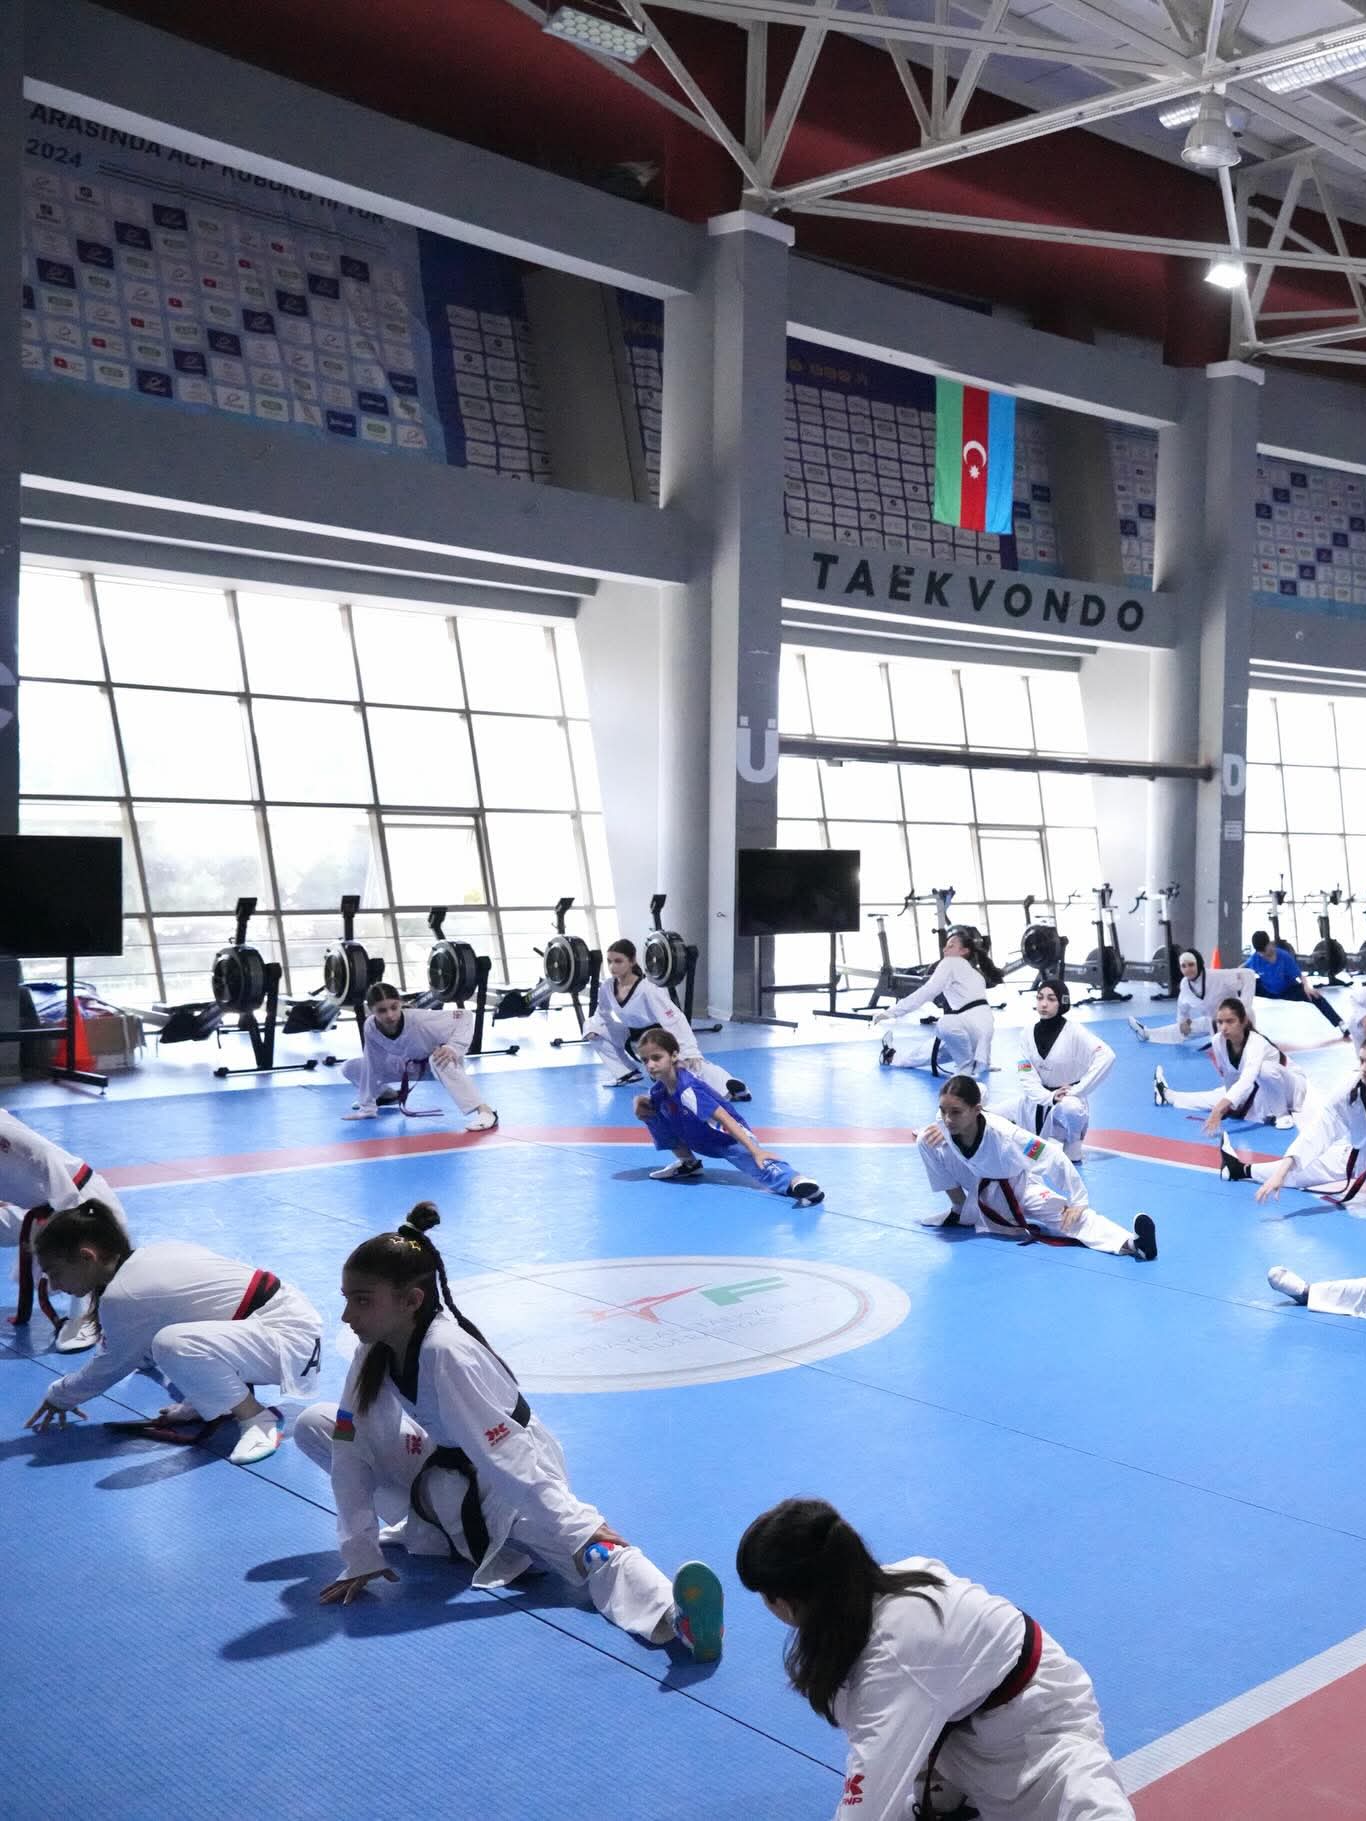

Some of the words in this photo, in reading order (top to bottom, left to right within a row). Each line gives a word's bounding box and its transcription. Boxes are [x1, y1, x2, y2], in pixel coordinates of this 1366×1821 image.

[25, 138, 82, 168] 2024
[29, 103, 161, 157] ARASINDA
[812, 552, 1145, 631] TAEKVONDO
